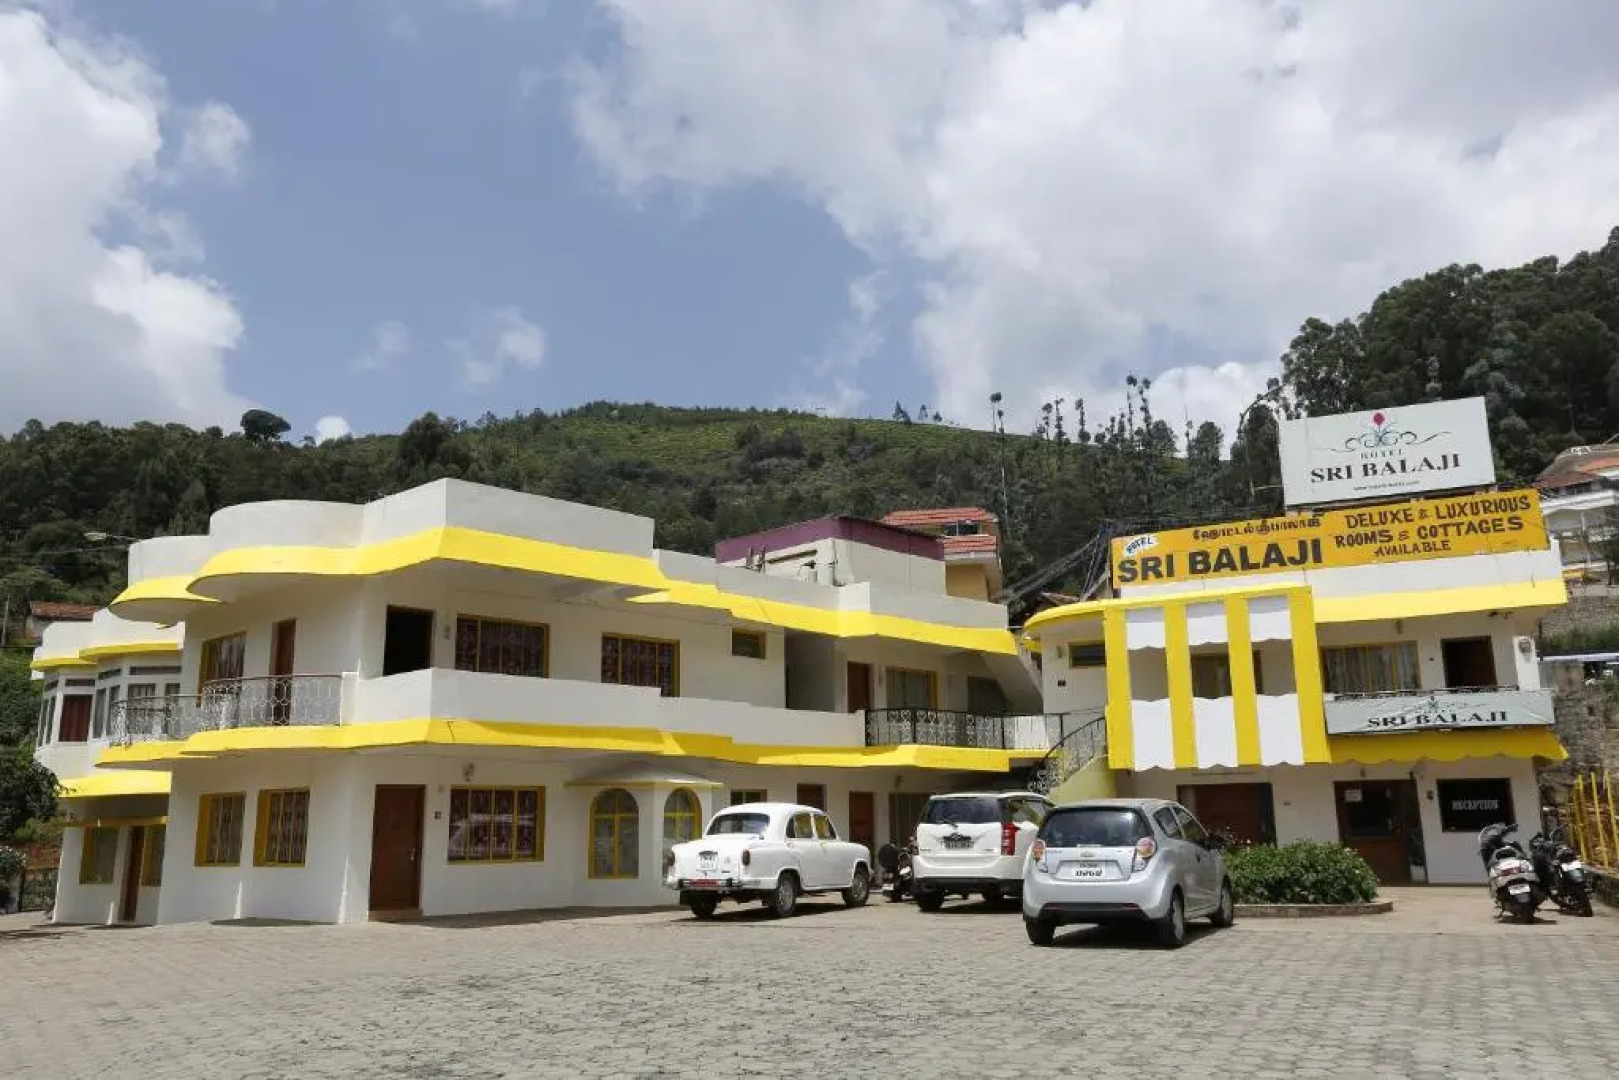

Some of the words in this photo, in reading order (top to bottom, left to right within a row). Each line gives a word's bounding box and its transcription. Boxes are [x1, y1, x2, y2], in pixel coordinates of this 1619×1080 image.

[1310, 464, 1353, 483] SRI
[1362, 453, 1462, 478] BALAJI
[1344, 508, 1415, 529] DELUXE
[1418, 508, 1429, 520] &
[1434, 495, 1531, 520] LUXURIOUS
[1334, 529, 1393, 548] ROOMS
[1416, 516, 1524, 540] COTTAGES
[1125, 537, 1154, 554] HOTEL
[1374, 540, 1451, 557] AVAILABLE
[1118, 554, 1175, 583] SRI
[1188, 538, 1323, 575] BALAJI
[1368, 716, 1407, 728] SRI
[1416, 710, 1508, 725] BALAJI
[1452, 799, 1499, 811] RECEPTION
